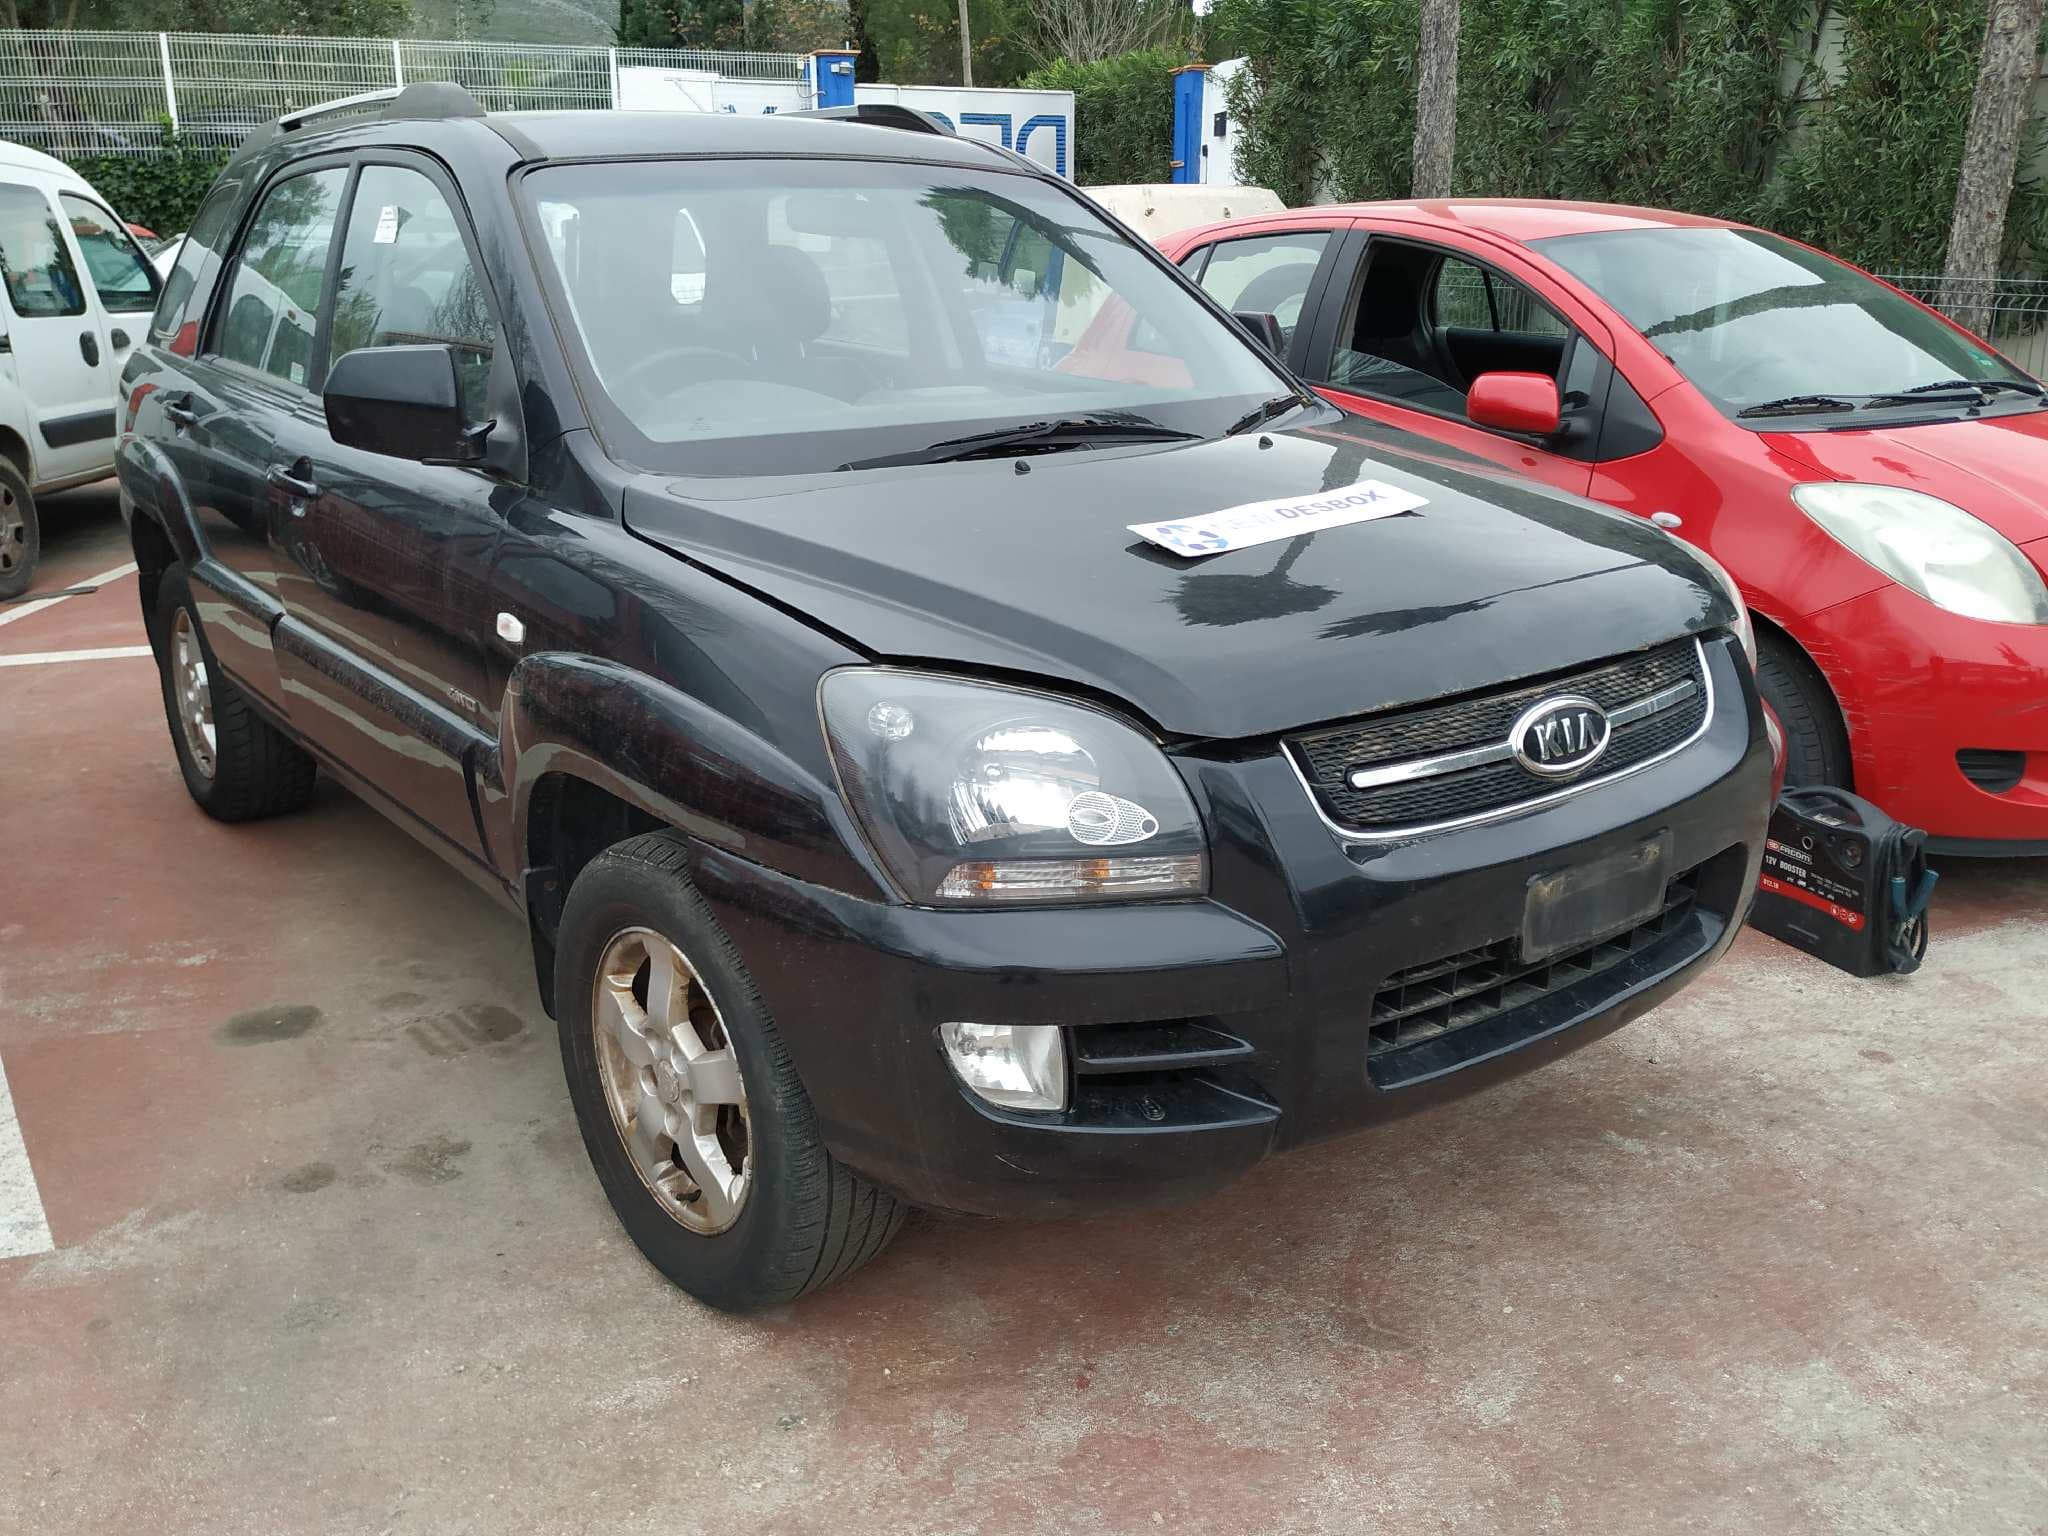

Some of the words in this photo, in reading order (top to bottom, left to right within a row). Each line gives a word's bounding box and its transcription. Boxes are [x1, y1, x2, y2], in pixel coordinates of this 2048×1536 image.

[1533, 712, 1601, 761] KIA
[1765, 855, 1777, 866] 12V
[1779, 860, 1807, 879] BOOSTER
